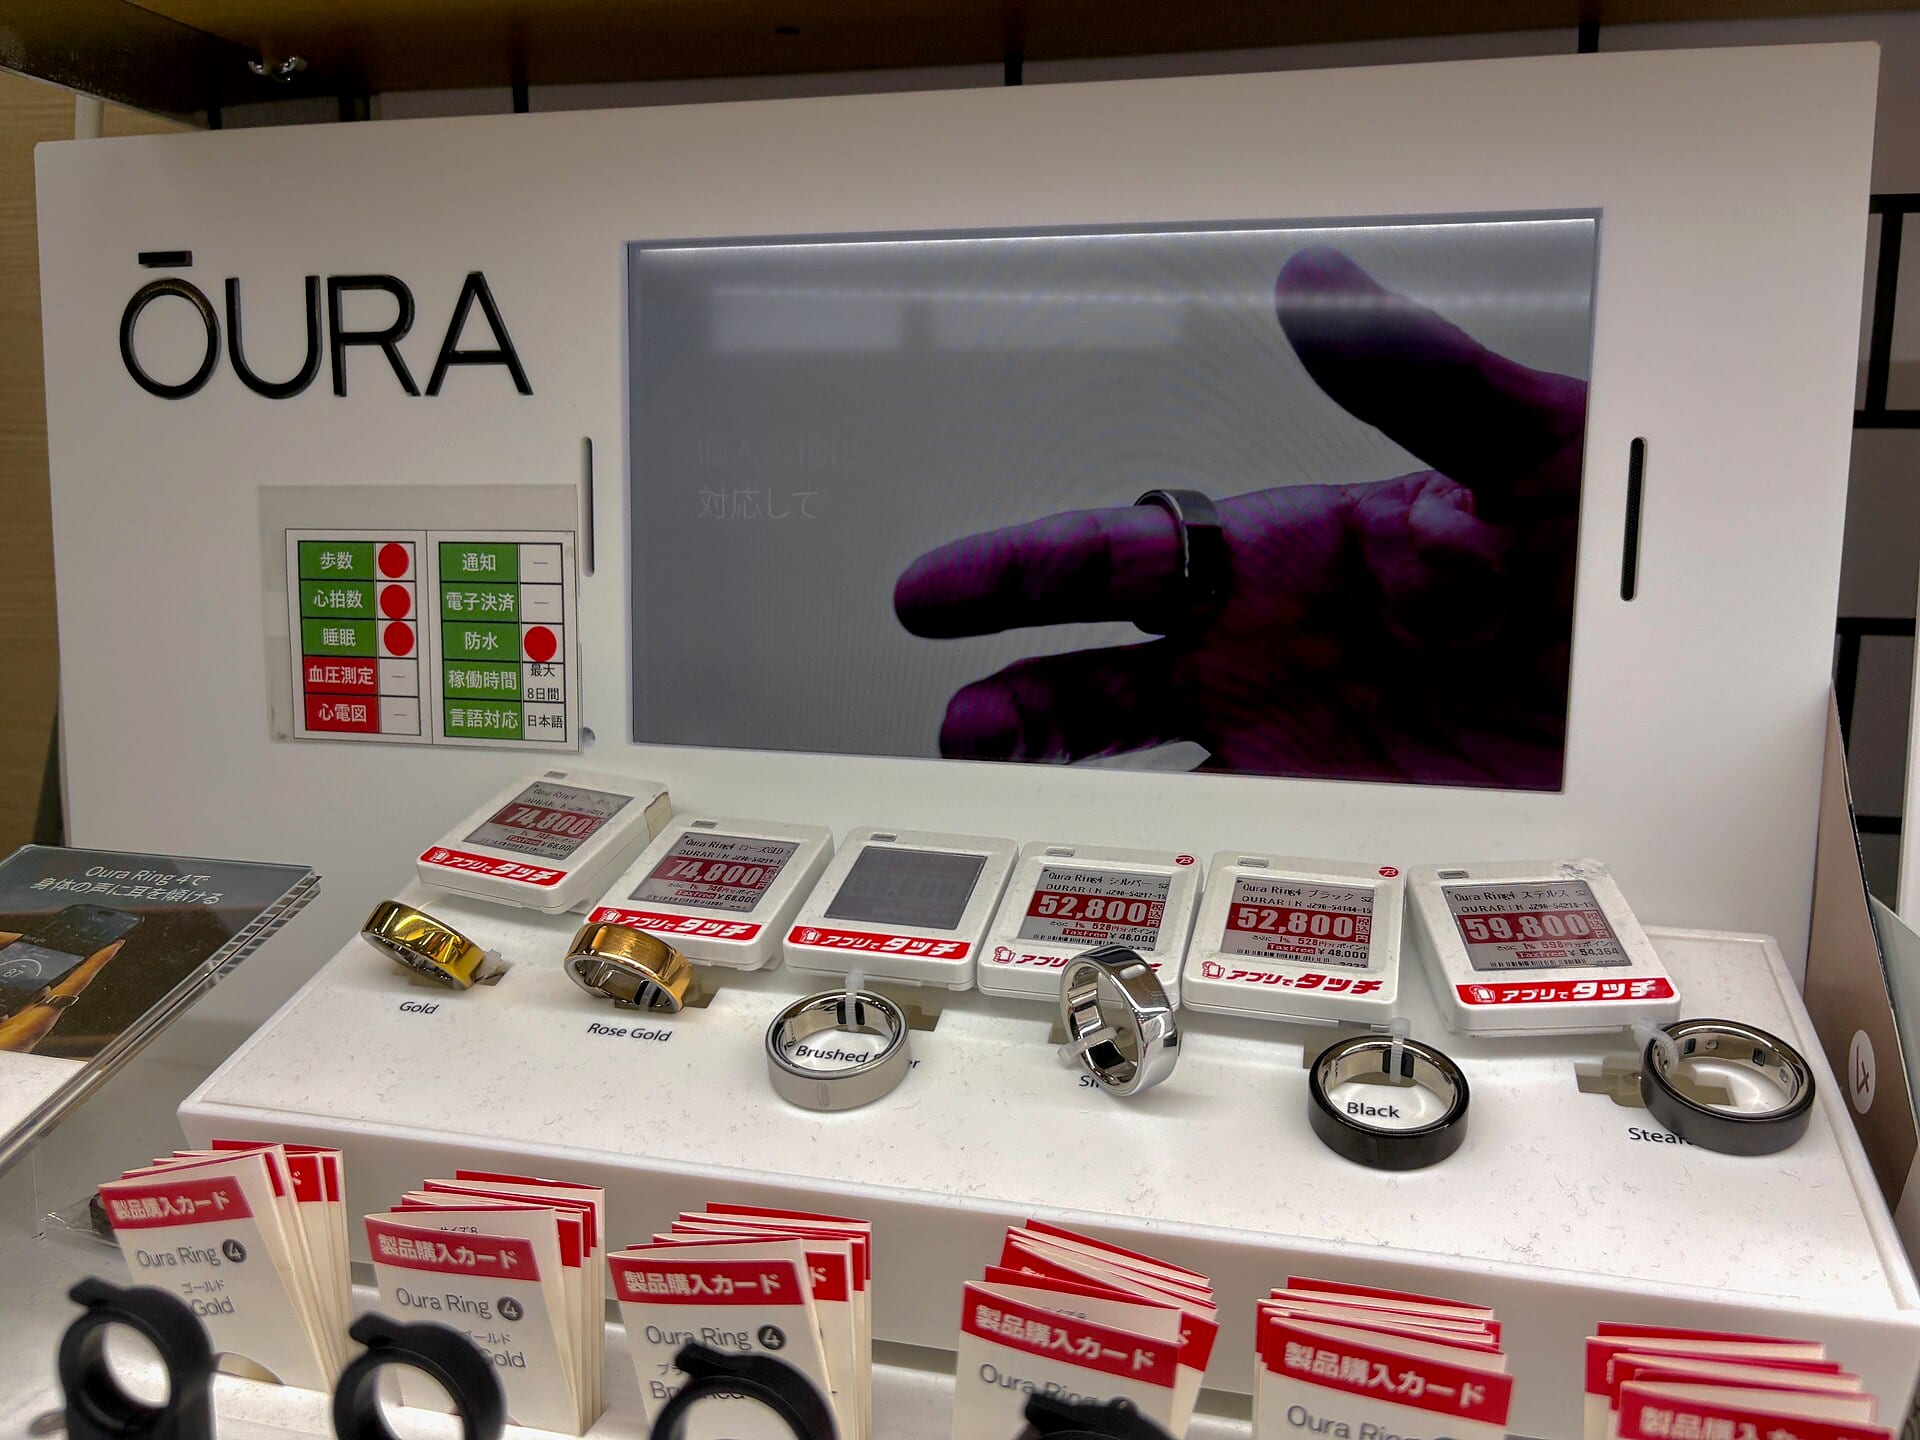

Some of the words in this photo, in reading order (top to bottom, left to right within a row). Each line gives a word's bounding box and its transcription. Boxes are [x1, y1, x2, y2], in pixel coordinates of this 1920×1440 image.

[698, 485, 819, 519] 対応して
[320, 552, 353, 569] 歩数
[462, 553, 496, 571] 通知
[314, 591, 363, 608] 心拍数
[446, 593, 515, 611] 電子決済
[323, 628, 356, 647] 睡眠
[464, 632, 498, 650] 防水
[308, 666, 374, 685] 血圧測定
[448, 671, 516, 690] 稼働時間
[530, 664, 556, 677] 最大
[527, 688, 560, 701] 8日間
[318, 704, 367, 722] 心電図
[450, 709, 518, 728] 言語対応
[527, 715, 563, 729] 日本語
[505, 806, 592, 835] 74,800
[85, 866, 130, 879] Oura
[131, 869, 174, 886] Ring
[444, 856, 557, 882] アプリでタッチ
[666, 860, 764, 885] 74,800
[1048, 872, 1071, 881] Oura
[1109, 878, 1152, 887] シルバー
[30, 877, 224, 905] 身体の声に耳を傾ける
[1243, 884, 1267, 893] Oura
[1308, 889, 1354, 901] ブラック
[1454, 891, 1481, 901] Oura
[1522, 889, 1569, 899] ステルス
[1038, 894, 1148, 923] 52,800
[621, 916, 753, 937] アプリでタッチ
[1237, 907, 1354, 938] 52,800
[1464, 914, 1590, 941] 59,800
[821, 935, 960, 956] アプリでタッチ
[1227, 970, 1383, 994] アプリでタッチ
[1502, 981, 1656, 1001] アプリでタッチ
[400, 1001, 440, 1015] Gold
[587, 1023, 628, 1038] Rose
[631, 1028, 672, 1043] Gold
[795, 1045, 869, 1063] Brushed
[1346, 1101, 1400, 1119] Black
[1628, 1127, 1693, 1145] Stea
[112, 1191, 230, 1220] 製品購入カード
[137, 1250, 176, 1268] Oura
[178, 1246, 221, 1266] Ring
[378, 1233, 518, 1269] 製品購入カード
[624, 1270, 780, 1295] 製品購入カード
[192, 1296, 235, 1317] Gold
[396, 1288, 441, 1311] Oura
[446, 1294, 492, 1320] Ring
[701, 1327, 752, 1350] Ring
[976, 1304, 1155, 1371] 製品購入カード
[980, 1364, 1036, 1394] Oura
[1285, 1341, 1486, 1408] 製品購入カード
[1287, 1405, 1350, 1439] Oura
